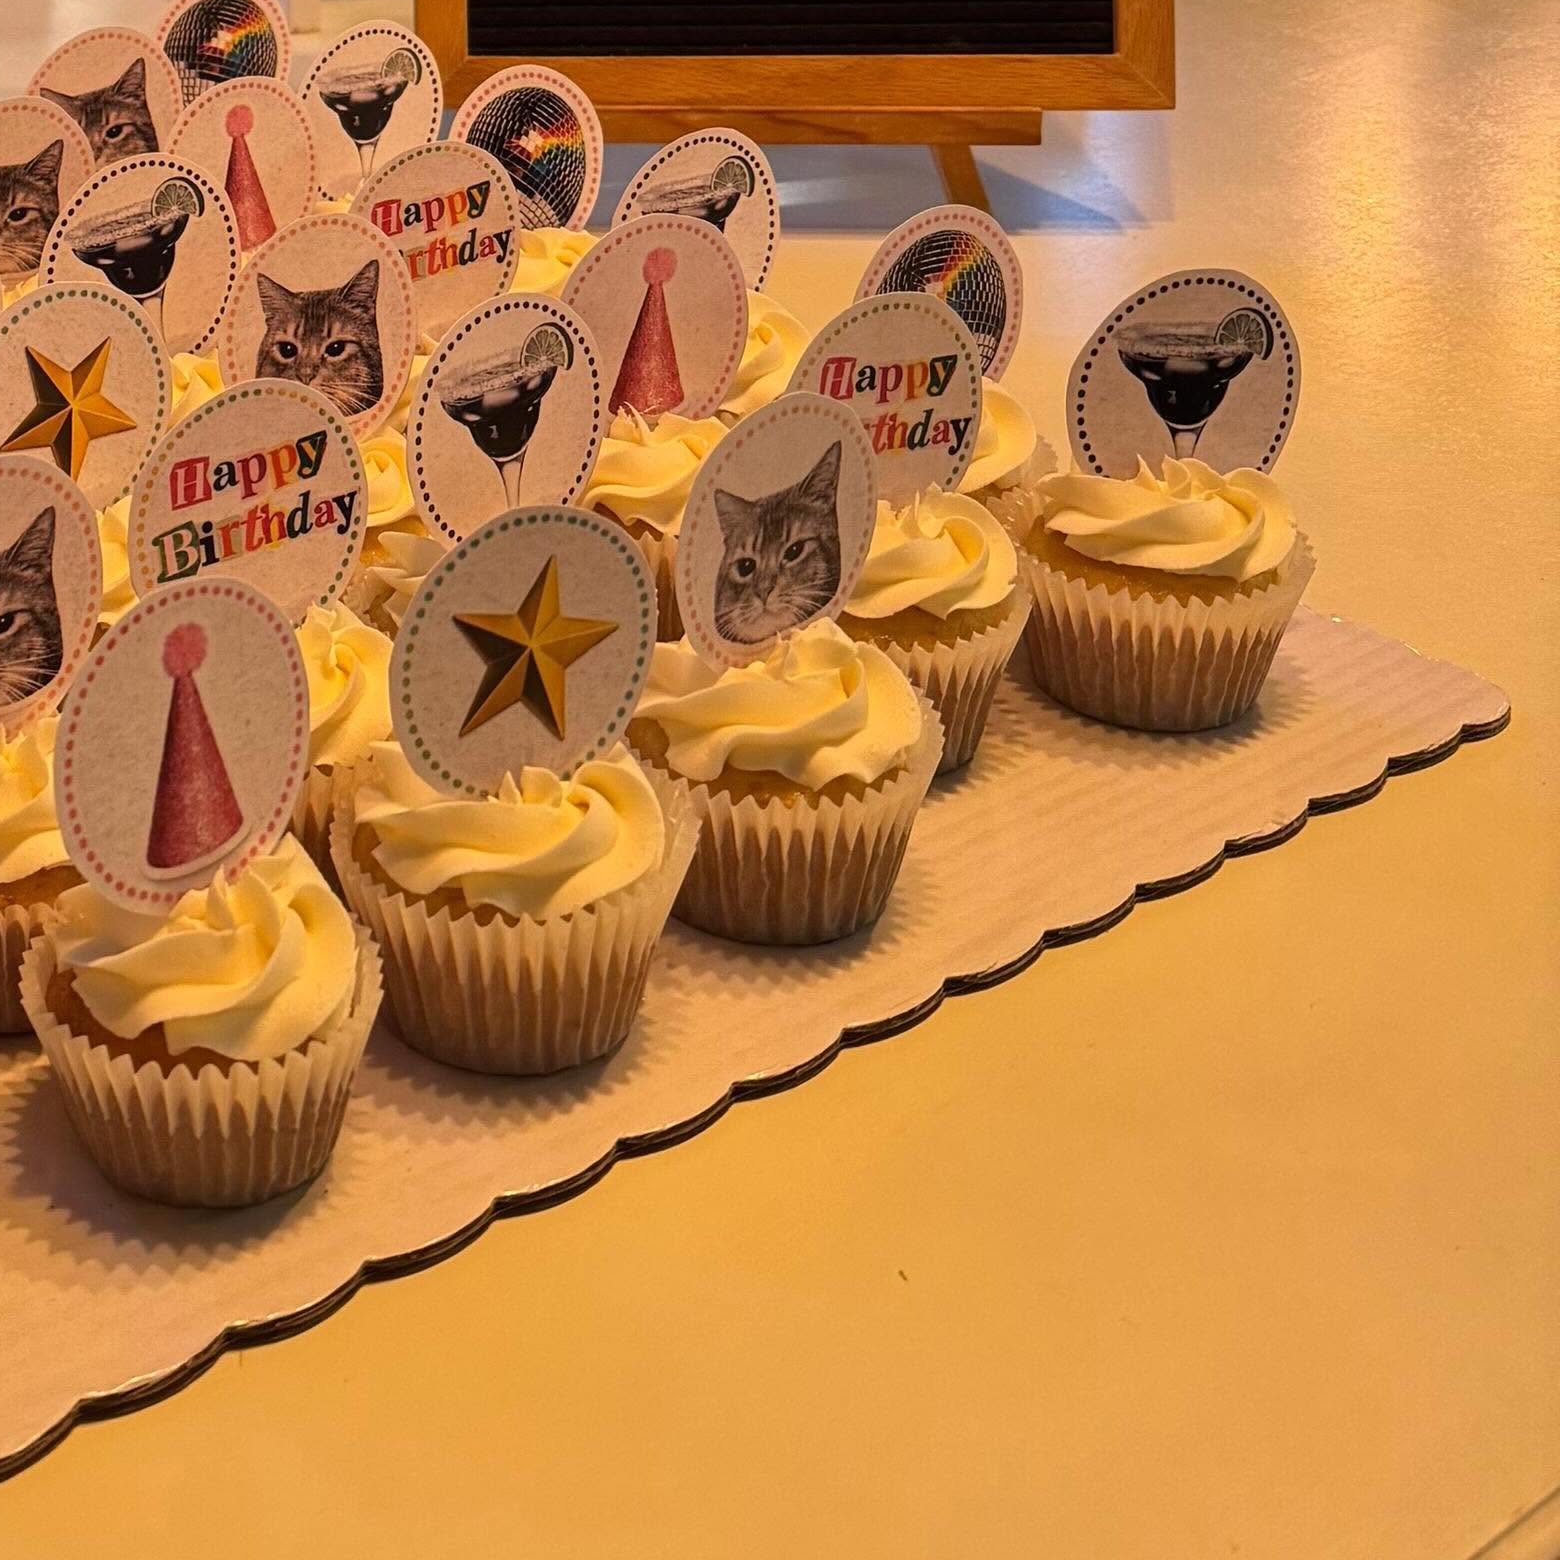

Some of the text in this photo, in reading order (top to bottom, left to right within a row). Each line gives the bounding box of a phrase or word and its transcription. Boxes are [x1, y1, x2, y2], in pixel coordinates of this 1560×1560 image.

[371, 179, 491, 237] Happy
[399, 227, 513, 282] rthday
[819, 354, 958, 405] Happy
[862, 408, 972, 456] thday
[169, 429, 328, 512] Happy
[151, 490, 358, 584] Birthday
